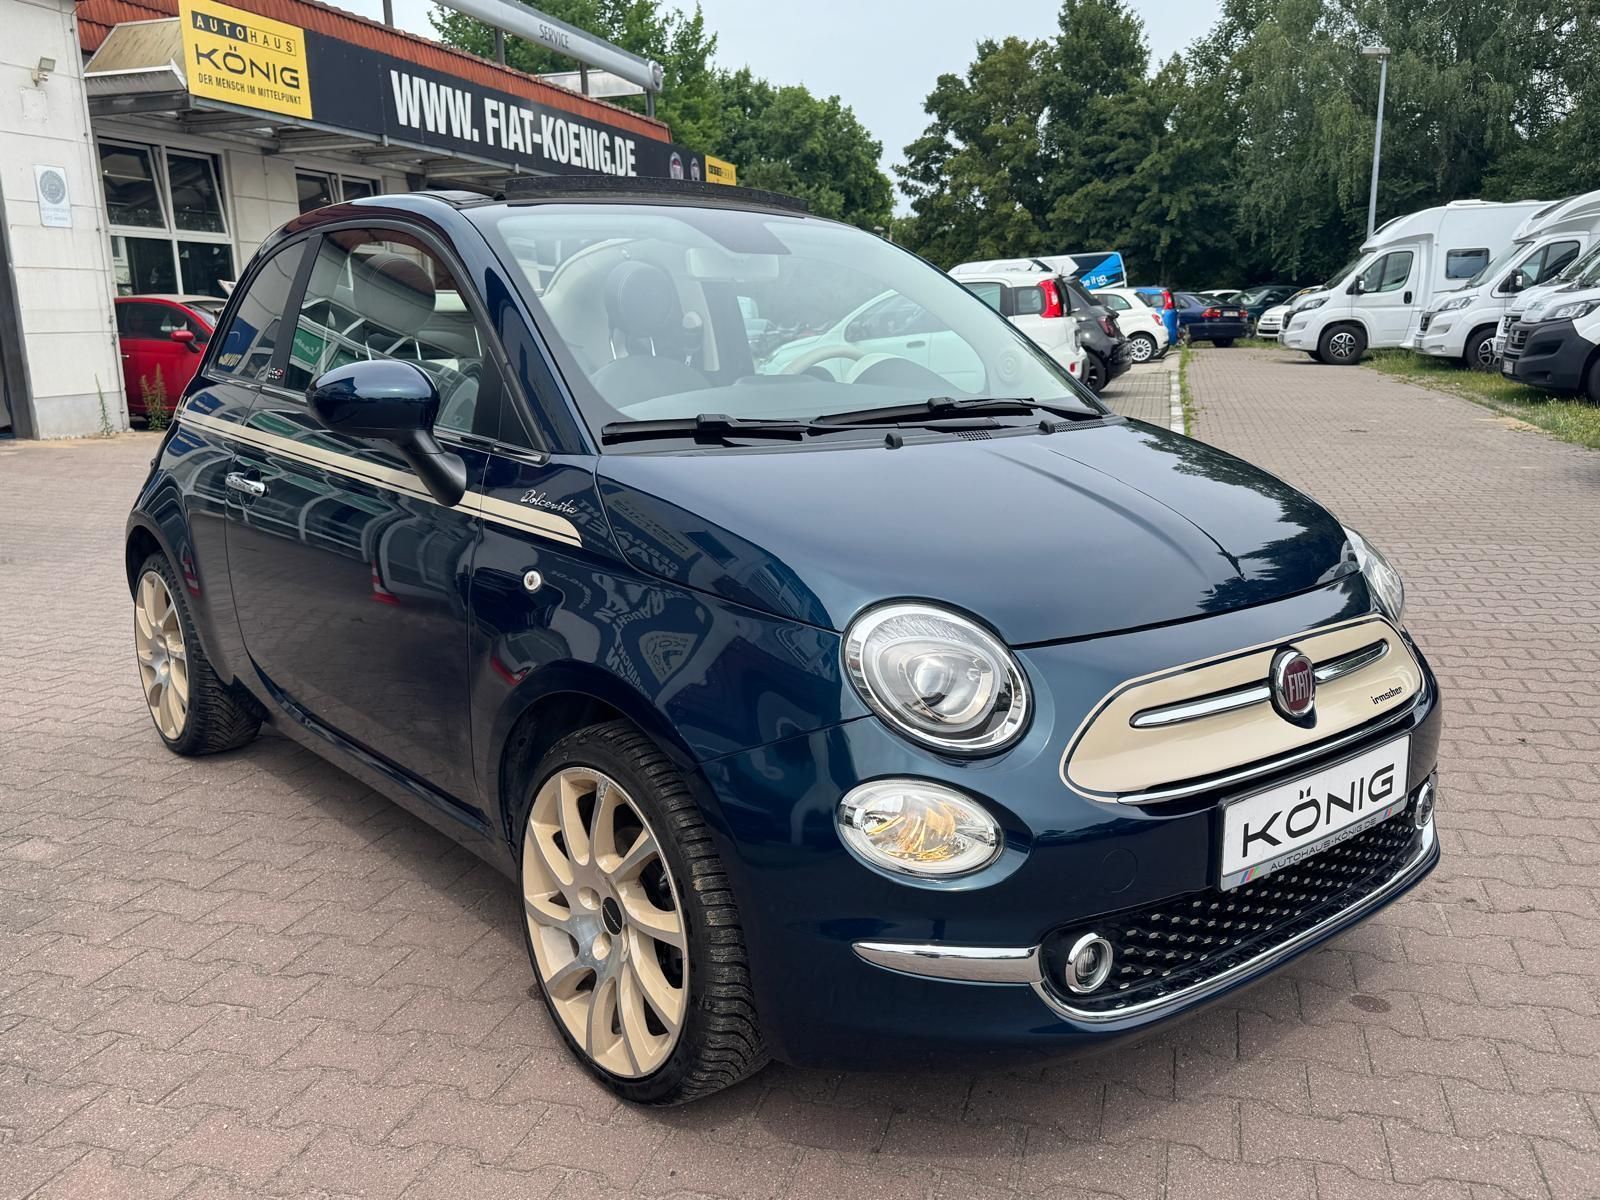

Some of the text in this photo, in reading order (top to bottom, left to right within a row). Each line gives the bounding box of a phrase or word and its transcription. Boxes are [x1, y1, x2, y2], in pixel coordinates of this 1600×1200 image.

[195, 14, 293, 54] AUTOHAUS
[538, 23, 570, 50] SERVICE
[194, 42, 300, 90] KÖNIG
[198, 72, 302, 105] DER MENSCH IM MITTELPUNKT
[389, 69, 637, 177] WWW. FIAT-KOENIG.DE
[520, 489, 578, 514] Dolcevita
[1287, 669, 1311, 702] FIAT
[1370, 685, 1403, 705] irmscher
[1241, 762, 1395, 859] KÖNIG
